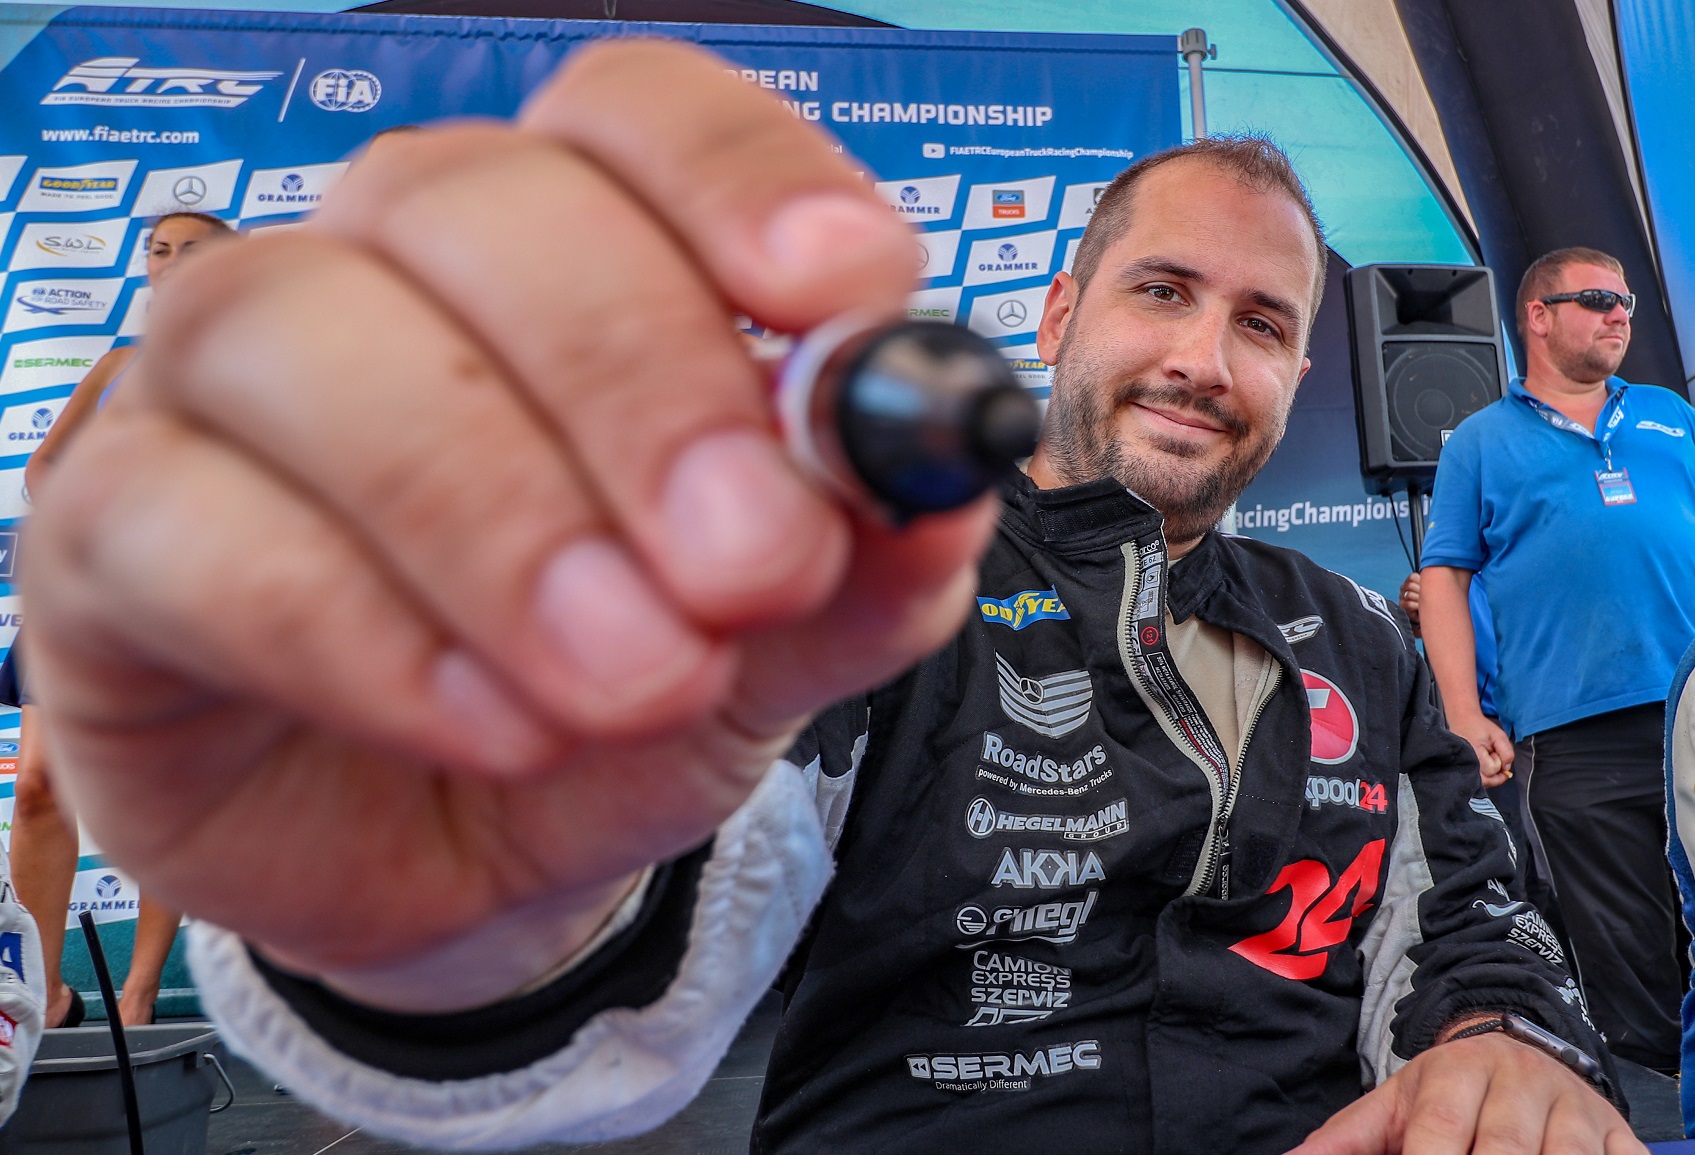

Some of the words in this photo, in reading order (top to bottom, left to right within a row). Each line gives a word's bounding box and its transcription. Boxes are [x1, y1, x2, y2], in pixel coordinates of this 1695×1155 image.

[832, 101, 1053, 127] CHAMPIONSHIP
[41, 126, 200, 143] www.fiaetrc.com
[41, 178, 117, 190] GOODYEAR
[890, 205, 941, 214] RAMMER
[978, 262, 1038, 272] GRAMMER
[45, 296, 70, 305] ROAD
[49, 288, 92, 300] ACTION
[906, 308, 950, 317] RMEC
[24, 357, 94, 368] SERMEC
[983, 733, 1107, 783] RoadStars
[978, 768, 1008, 786] powered
[1009, 778, 1019, 791] by
[1019, 782, 1089, 796] Mercedes-Benz
[1088, 768, 1113, 788] Trucks
[996, 801, 1127, 832] HEGELMANN
[1068, 823, 1125, 840] GROUP
[69, 900, 139, 911] GRAMME
[1227, 838, 1386, 980] 24
[973, 950, 1072, 976] CAMION
[971, 970, 1071, 989] EXPRESS
[931, 1043, 1099, 1080] SERMEC
[935, 1080, 988, 1091] Dramatically
[989, 1080, 1028, 1089] Different
